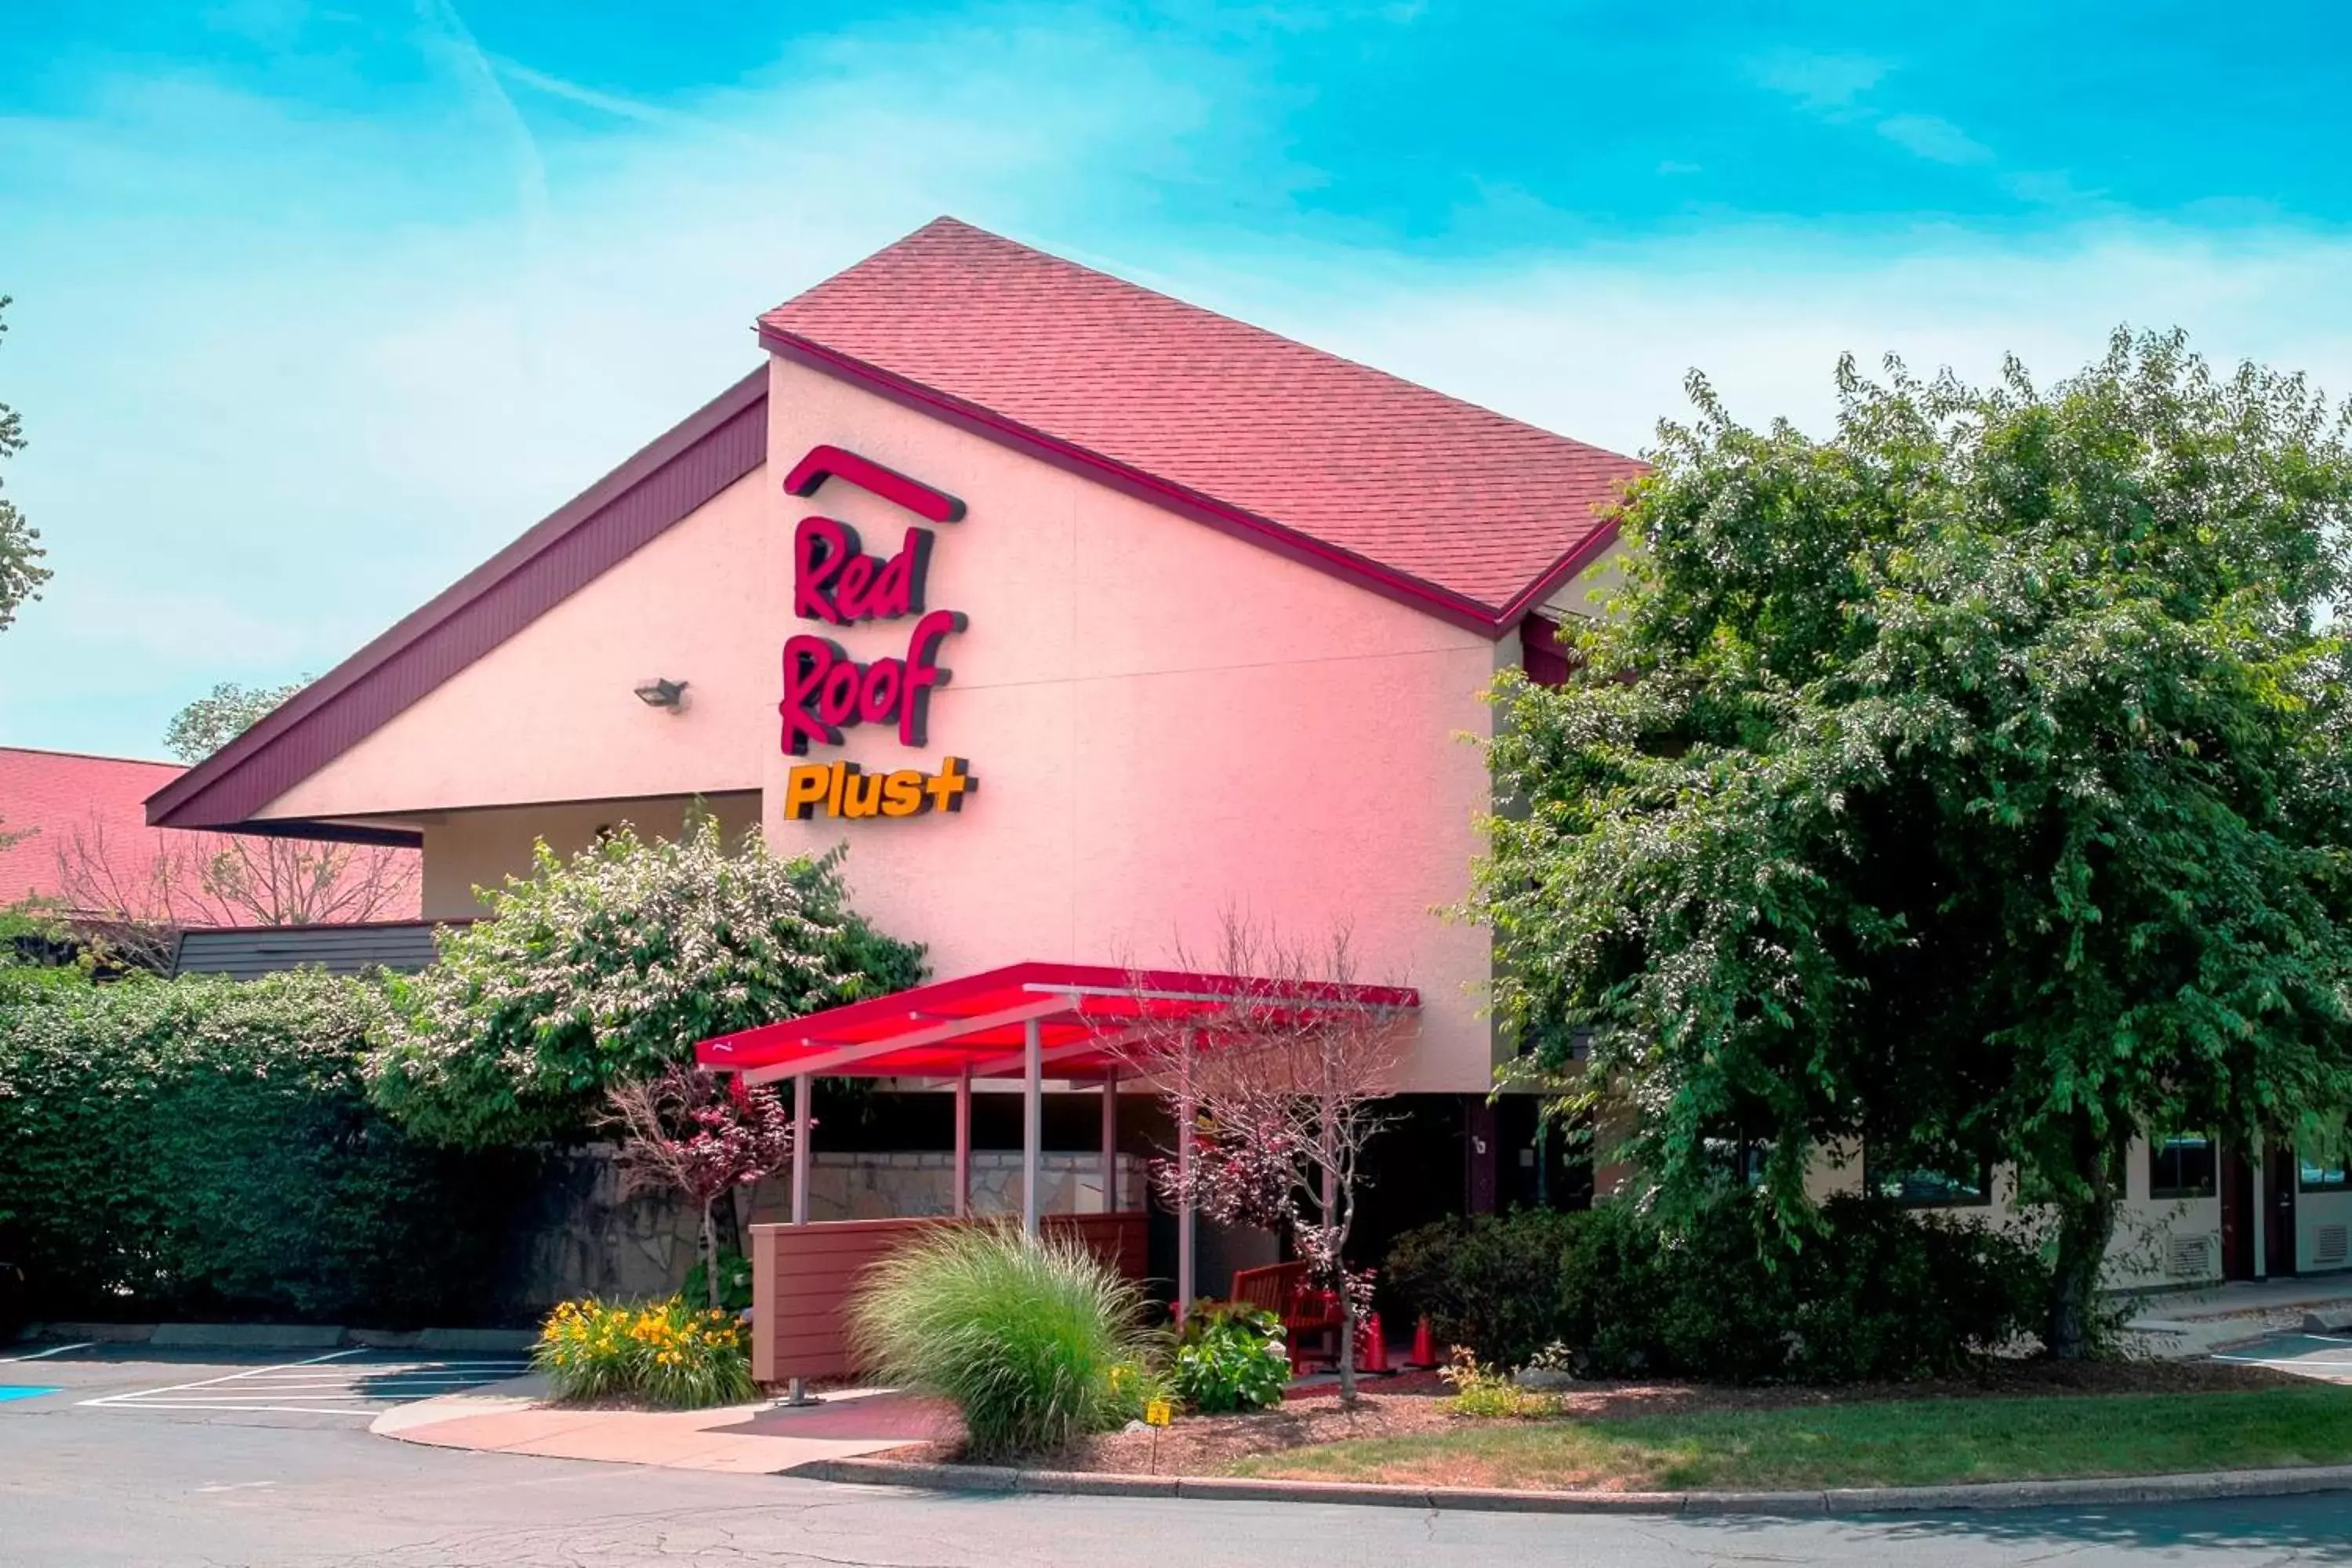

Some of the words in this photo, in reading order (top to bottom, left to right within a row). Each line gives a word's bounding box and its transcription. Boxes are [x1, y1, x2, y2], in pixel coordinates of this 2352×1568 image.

[794, 516, 927, 625] Red
[779, 610, 960, 755] Roof
[785, 757, 970, 820] Plus+
